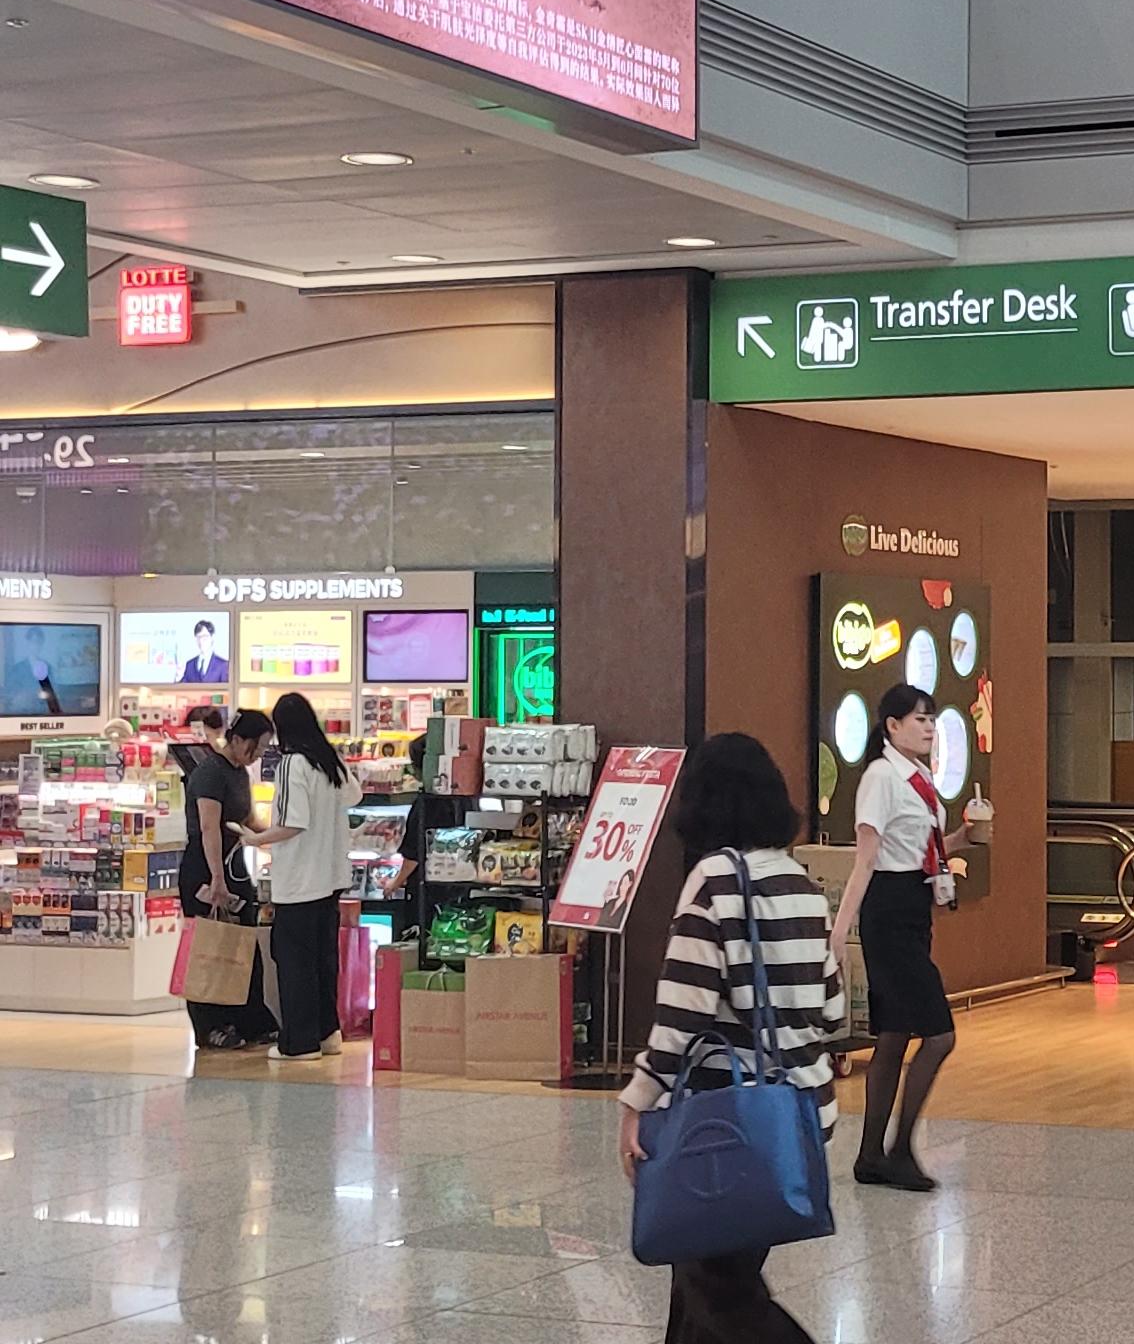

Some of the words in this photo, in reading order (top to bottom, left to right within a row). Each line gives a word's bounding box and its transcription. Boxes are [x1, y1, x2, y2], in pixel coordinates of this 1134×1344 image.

[121, 268, 187, 287] LOTTE
[126, 294, 182, 314] DUTY
[869, 288, 994, 329] Transfer
[1003, 284, 1078, 324] Desk
[127, 315, 182, 335] FREE
[870, 525, 898, 551] Live
[900, 527, 959, 557] Delicious
[269, 578, 403, 601] SUPPLEMENTS
[627, 824, 643, 835] OFF
